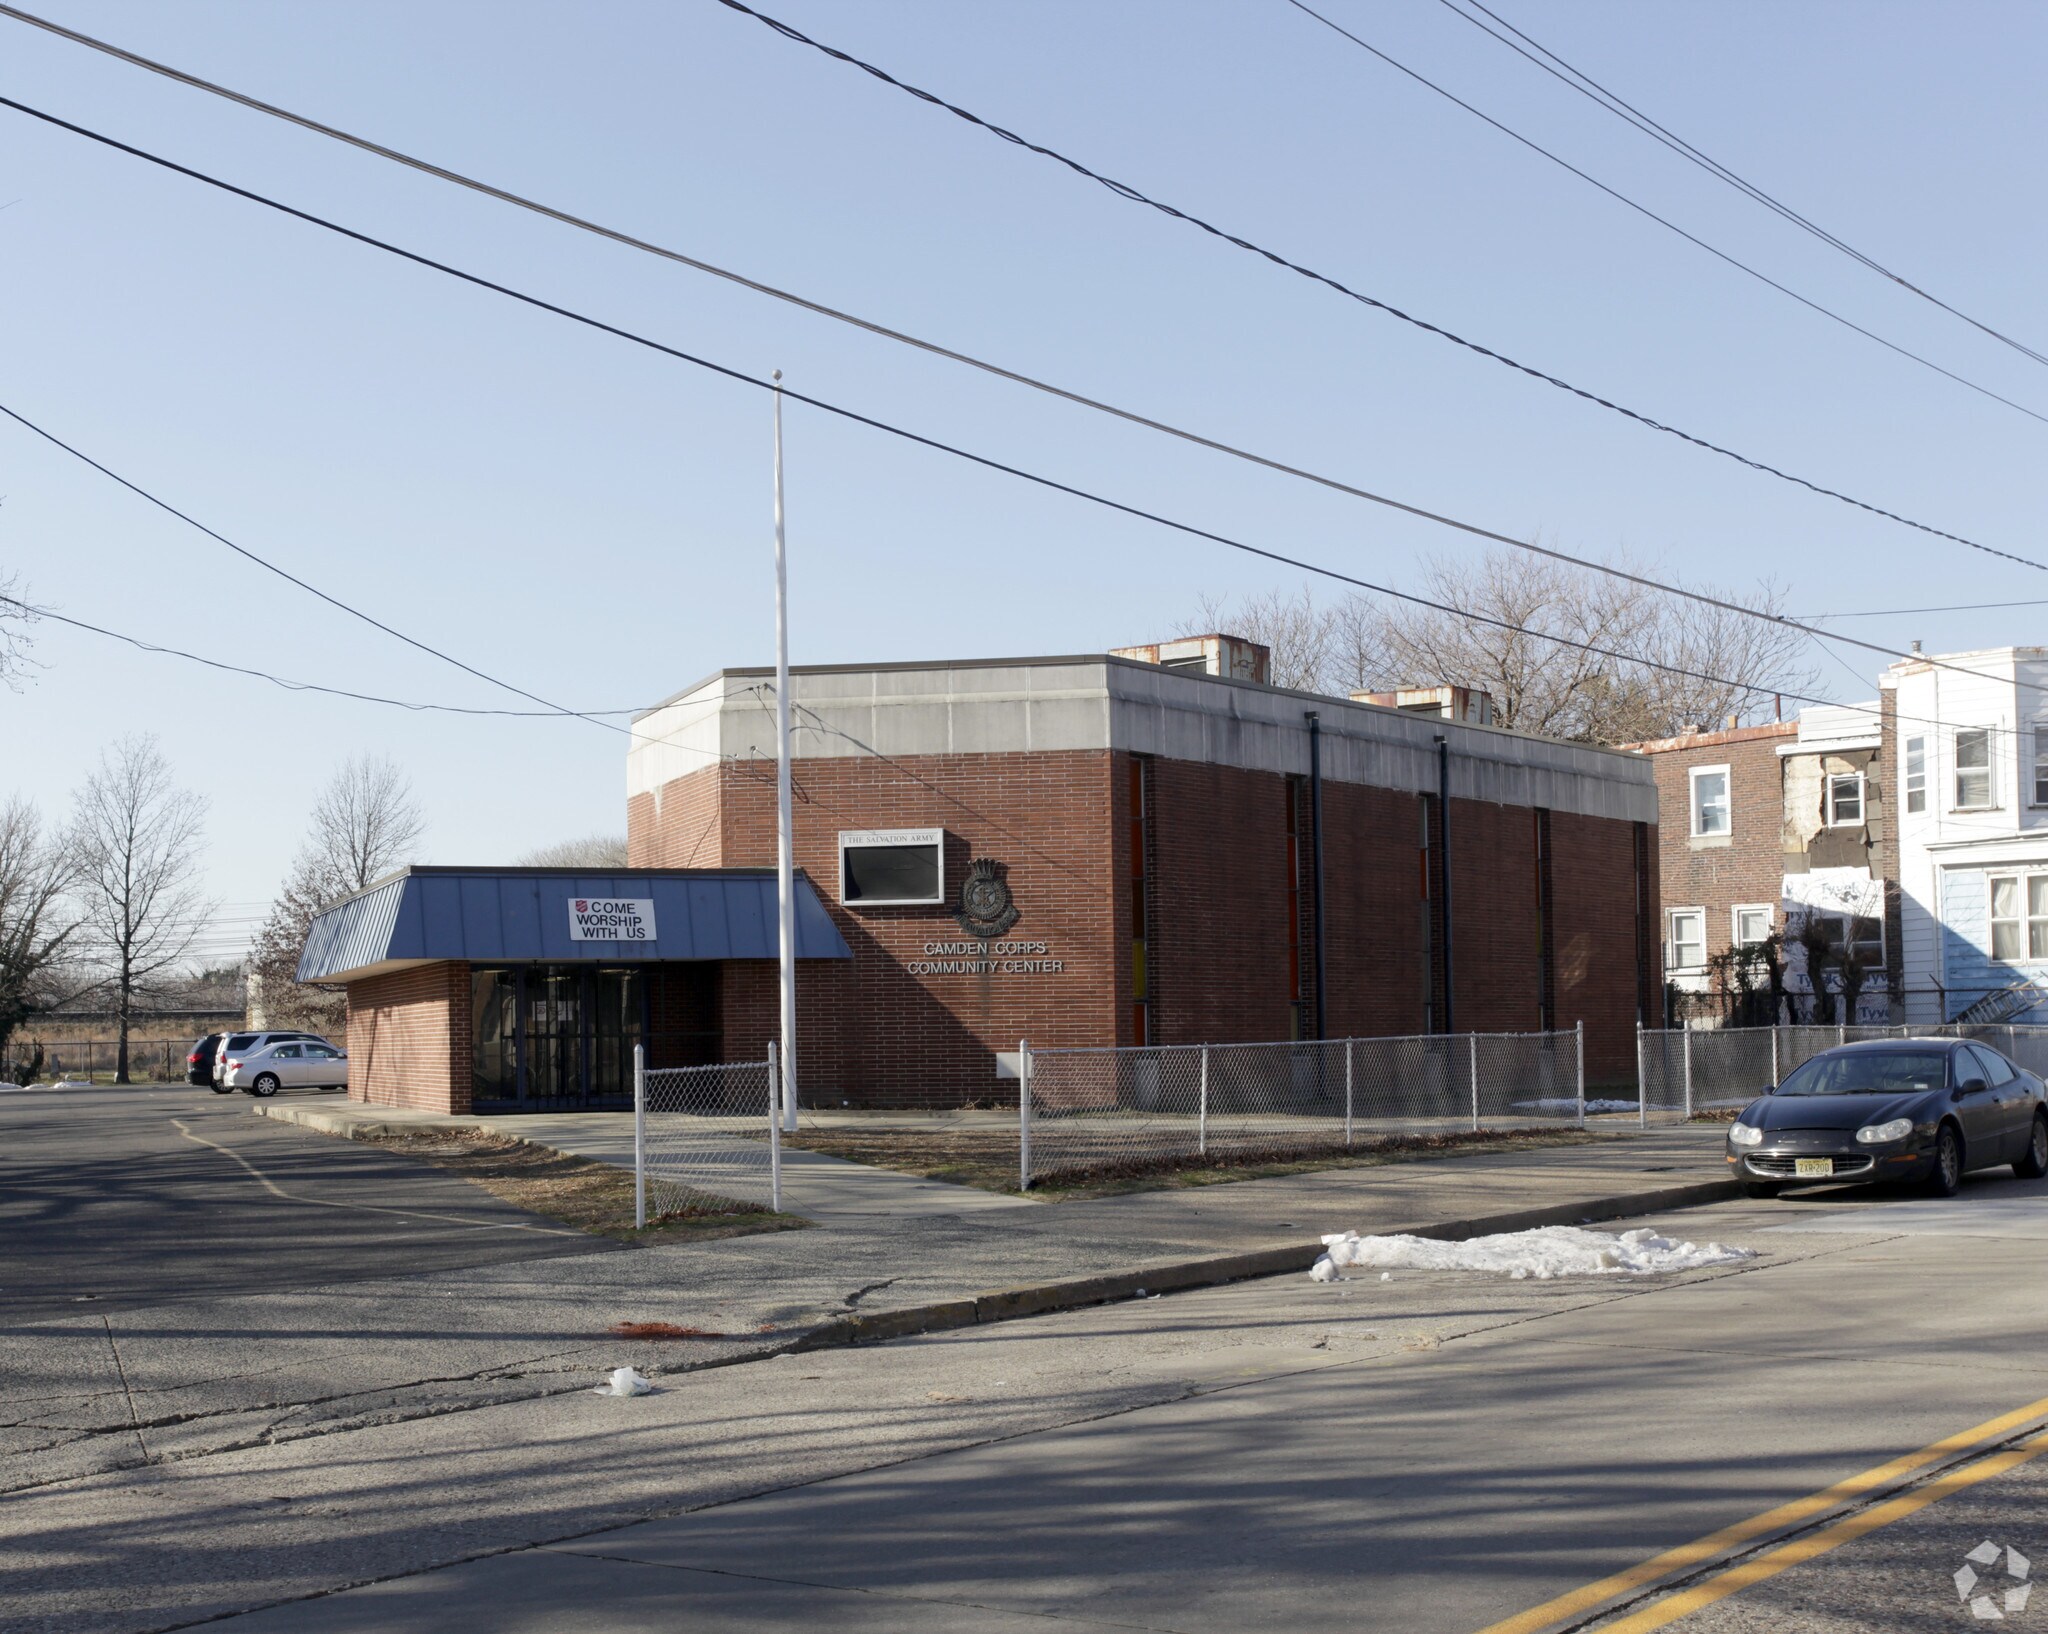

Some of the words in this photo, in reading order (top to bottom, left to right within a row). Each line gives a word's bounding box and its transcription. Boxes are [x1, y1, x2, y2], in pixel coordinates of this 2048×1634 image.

[848, 836, 865, 844] THE
[866, 834, 908, 843] SALVATION
[910, 834, 935, 842] ARMY
[591, 901, 636, 914] COME
[576, 914, 642, 927] WORSHIP
[582, 927, 618, 939] WITH
[626, 927, 646, 939] US
[924, 942, 988, 955] CAMDEN
[995, 941, 1046, 954] CORPS
[907, 961, 998, 974] COMMUNITY
[1003, 960, 1063, 973] CENTER
